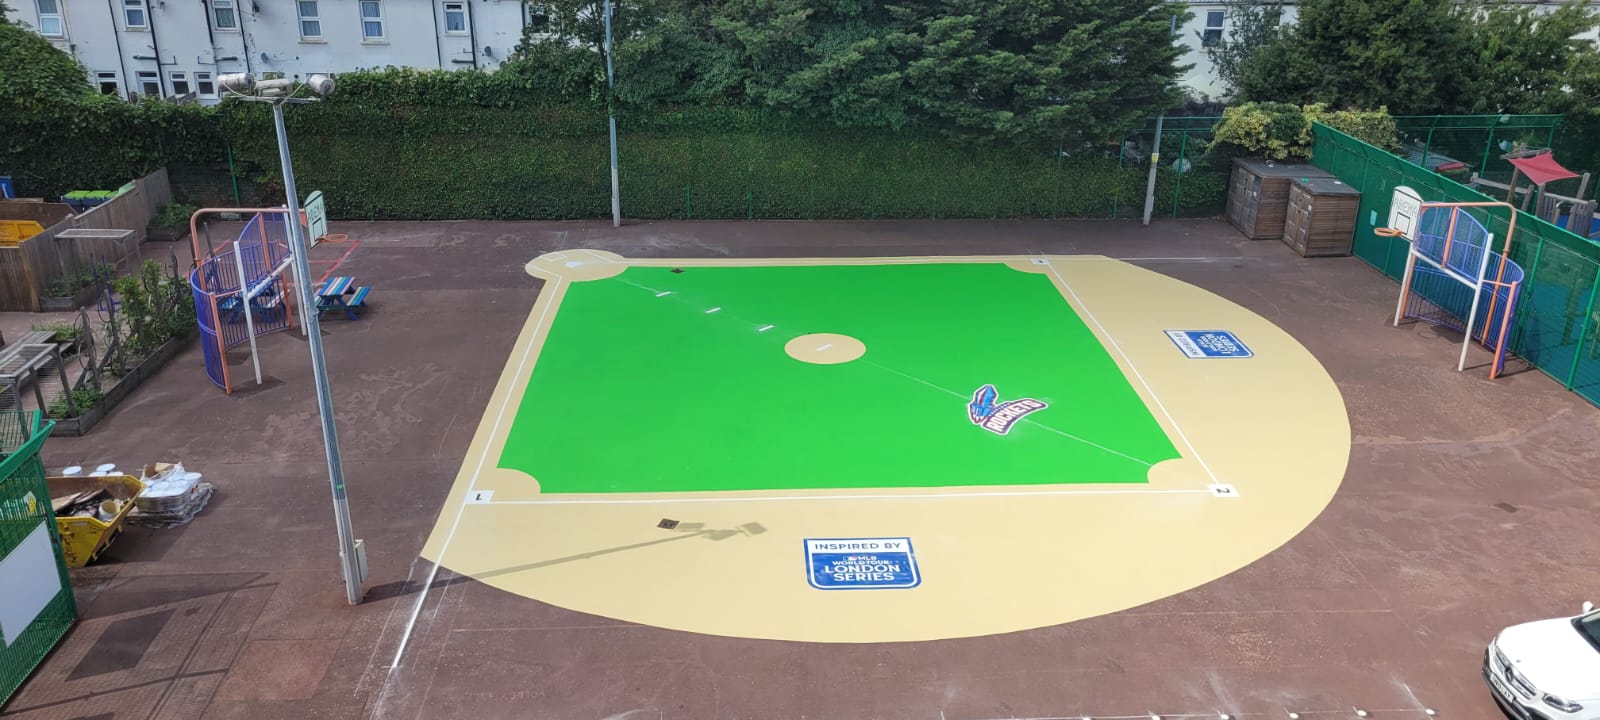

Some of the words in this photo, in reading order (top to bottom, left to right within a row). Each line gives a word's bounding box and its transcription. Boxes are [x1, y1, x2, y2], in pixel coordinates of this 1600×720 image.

[985, 400, 1043, 432] ROCKETS
[824, 565, 900, 574] LONDON
[833, 573, 895, 581] SERIES
